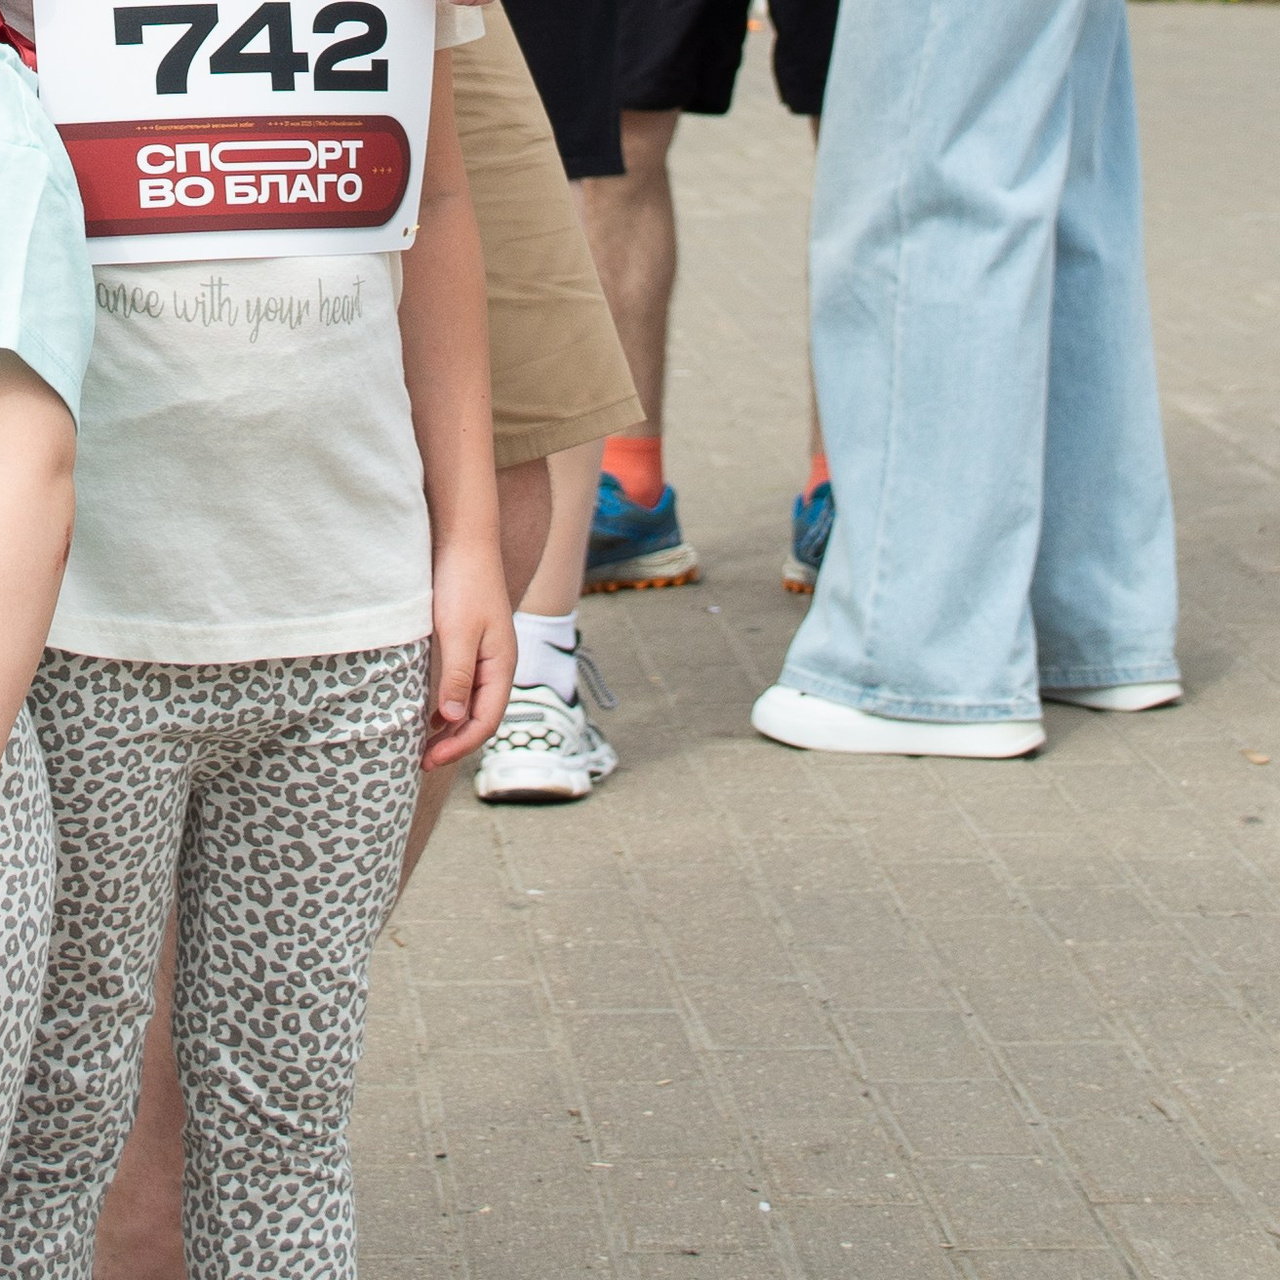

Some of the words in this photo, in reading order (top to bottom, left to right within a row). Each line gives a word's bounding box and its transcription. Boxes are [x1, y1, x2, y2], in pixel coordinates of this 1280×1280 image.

[113, 1, 389, 95] 742
[136, 140, 364, 175] СПОРТ
[138, 174, 215, 209] ВО
[225, 172, 364, 207] БЛАГО
[96, 281, 164, 319] ance
[173, 275, 240, 328] with
[245, 294, 310, 344] your
[317, 274, 367, 327] heart
